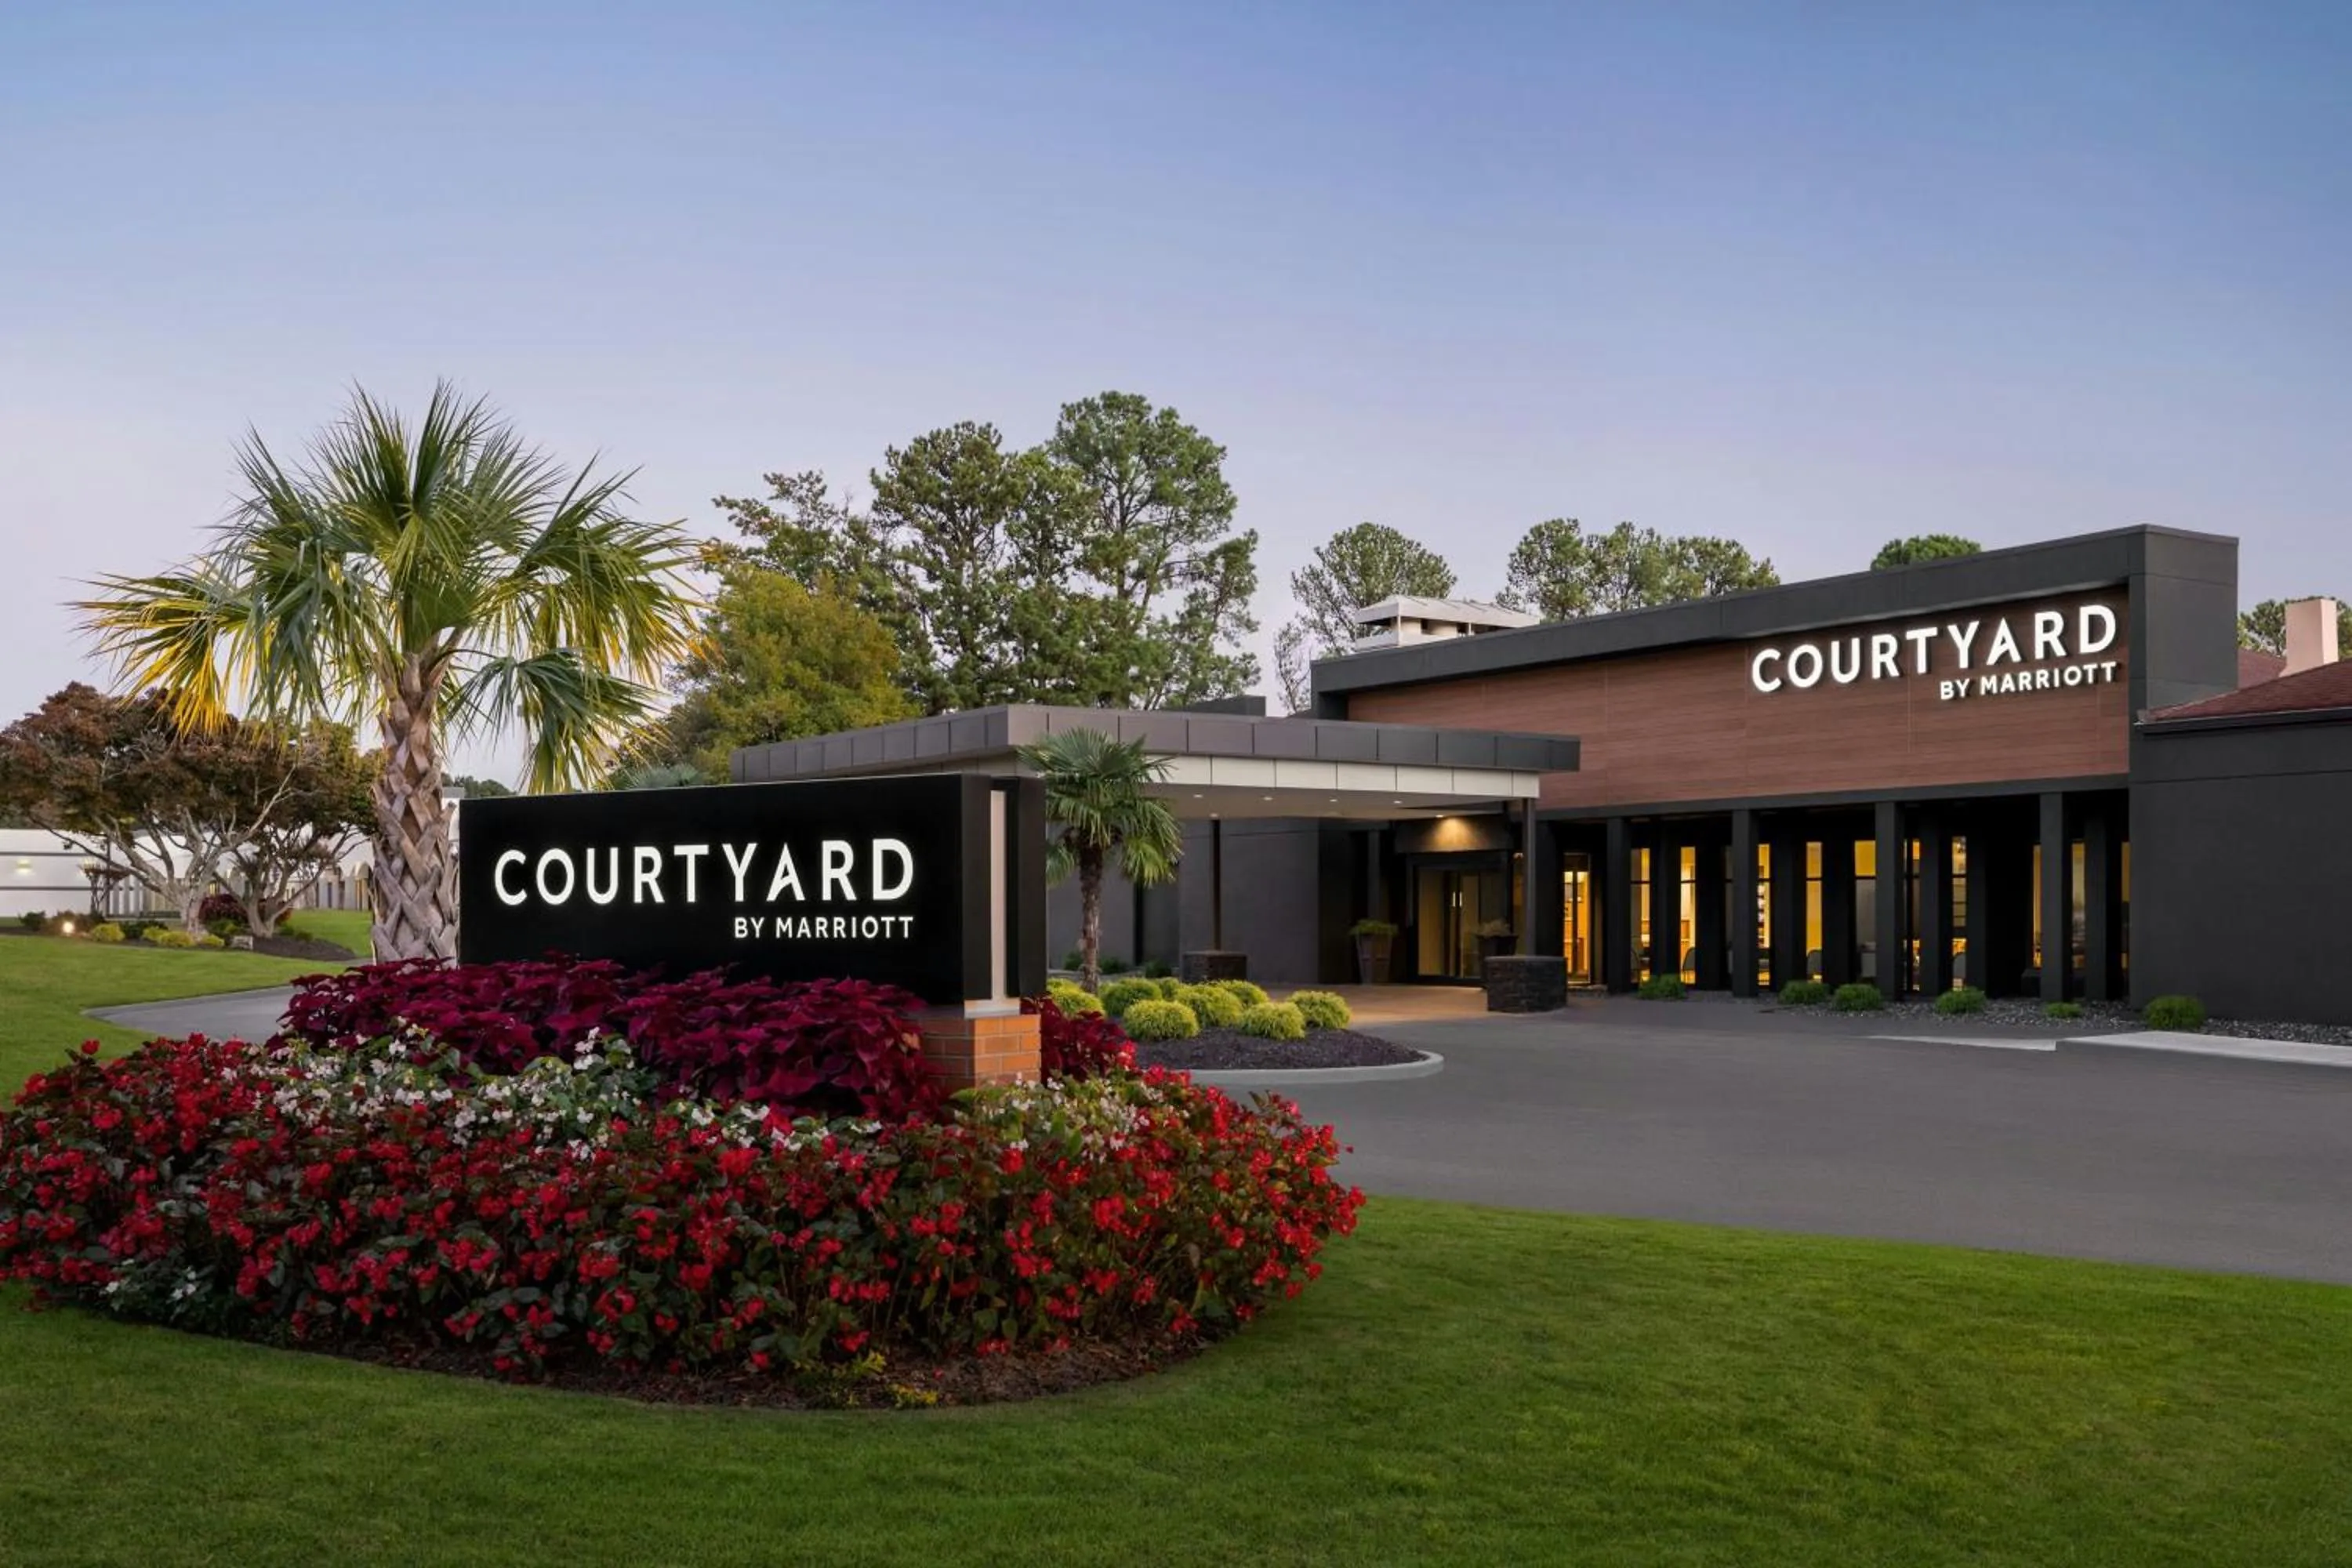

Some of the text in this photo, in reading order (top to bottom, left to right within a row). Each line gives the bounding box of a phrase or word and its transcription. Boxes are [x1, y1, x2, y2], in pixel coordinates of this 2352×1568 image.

[1751, 604, 2118, 693] COURTYARD
[1939, 660, 2118, 701] BY MARRIOTT
[494, 837, 915, 906] COURTYARD
[734, 915, 914, 939] BY MARRIOTT
